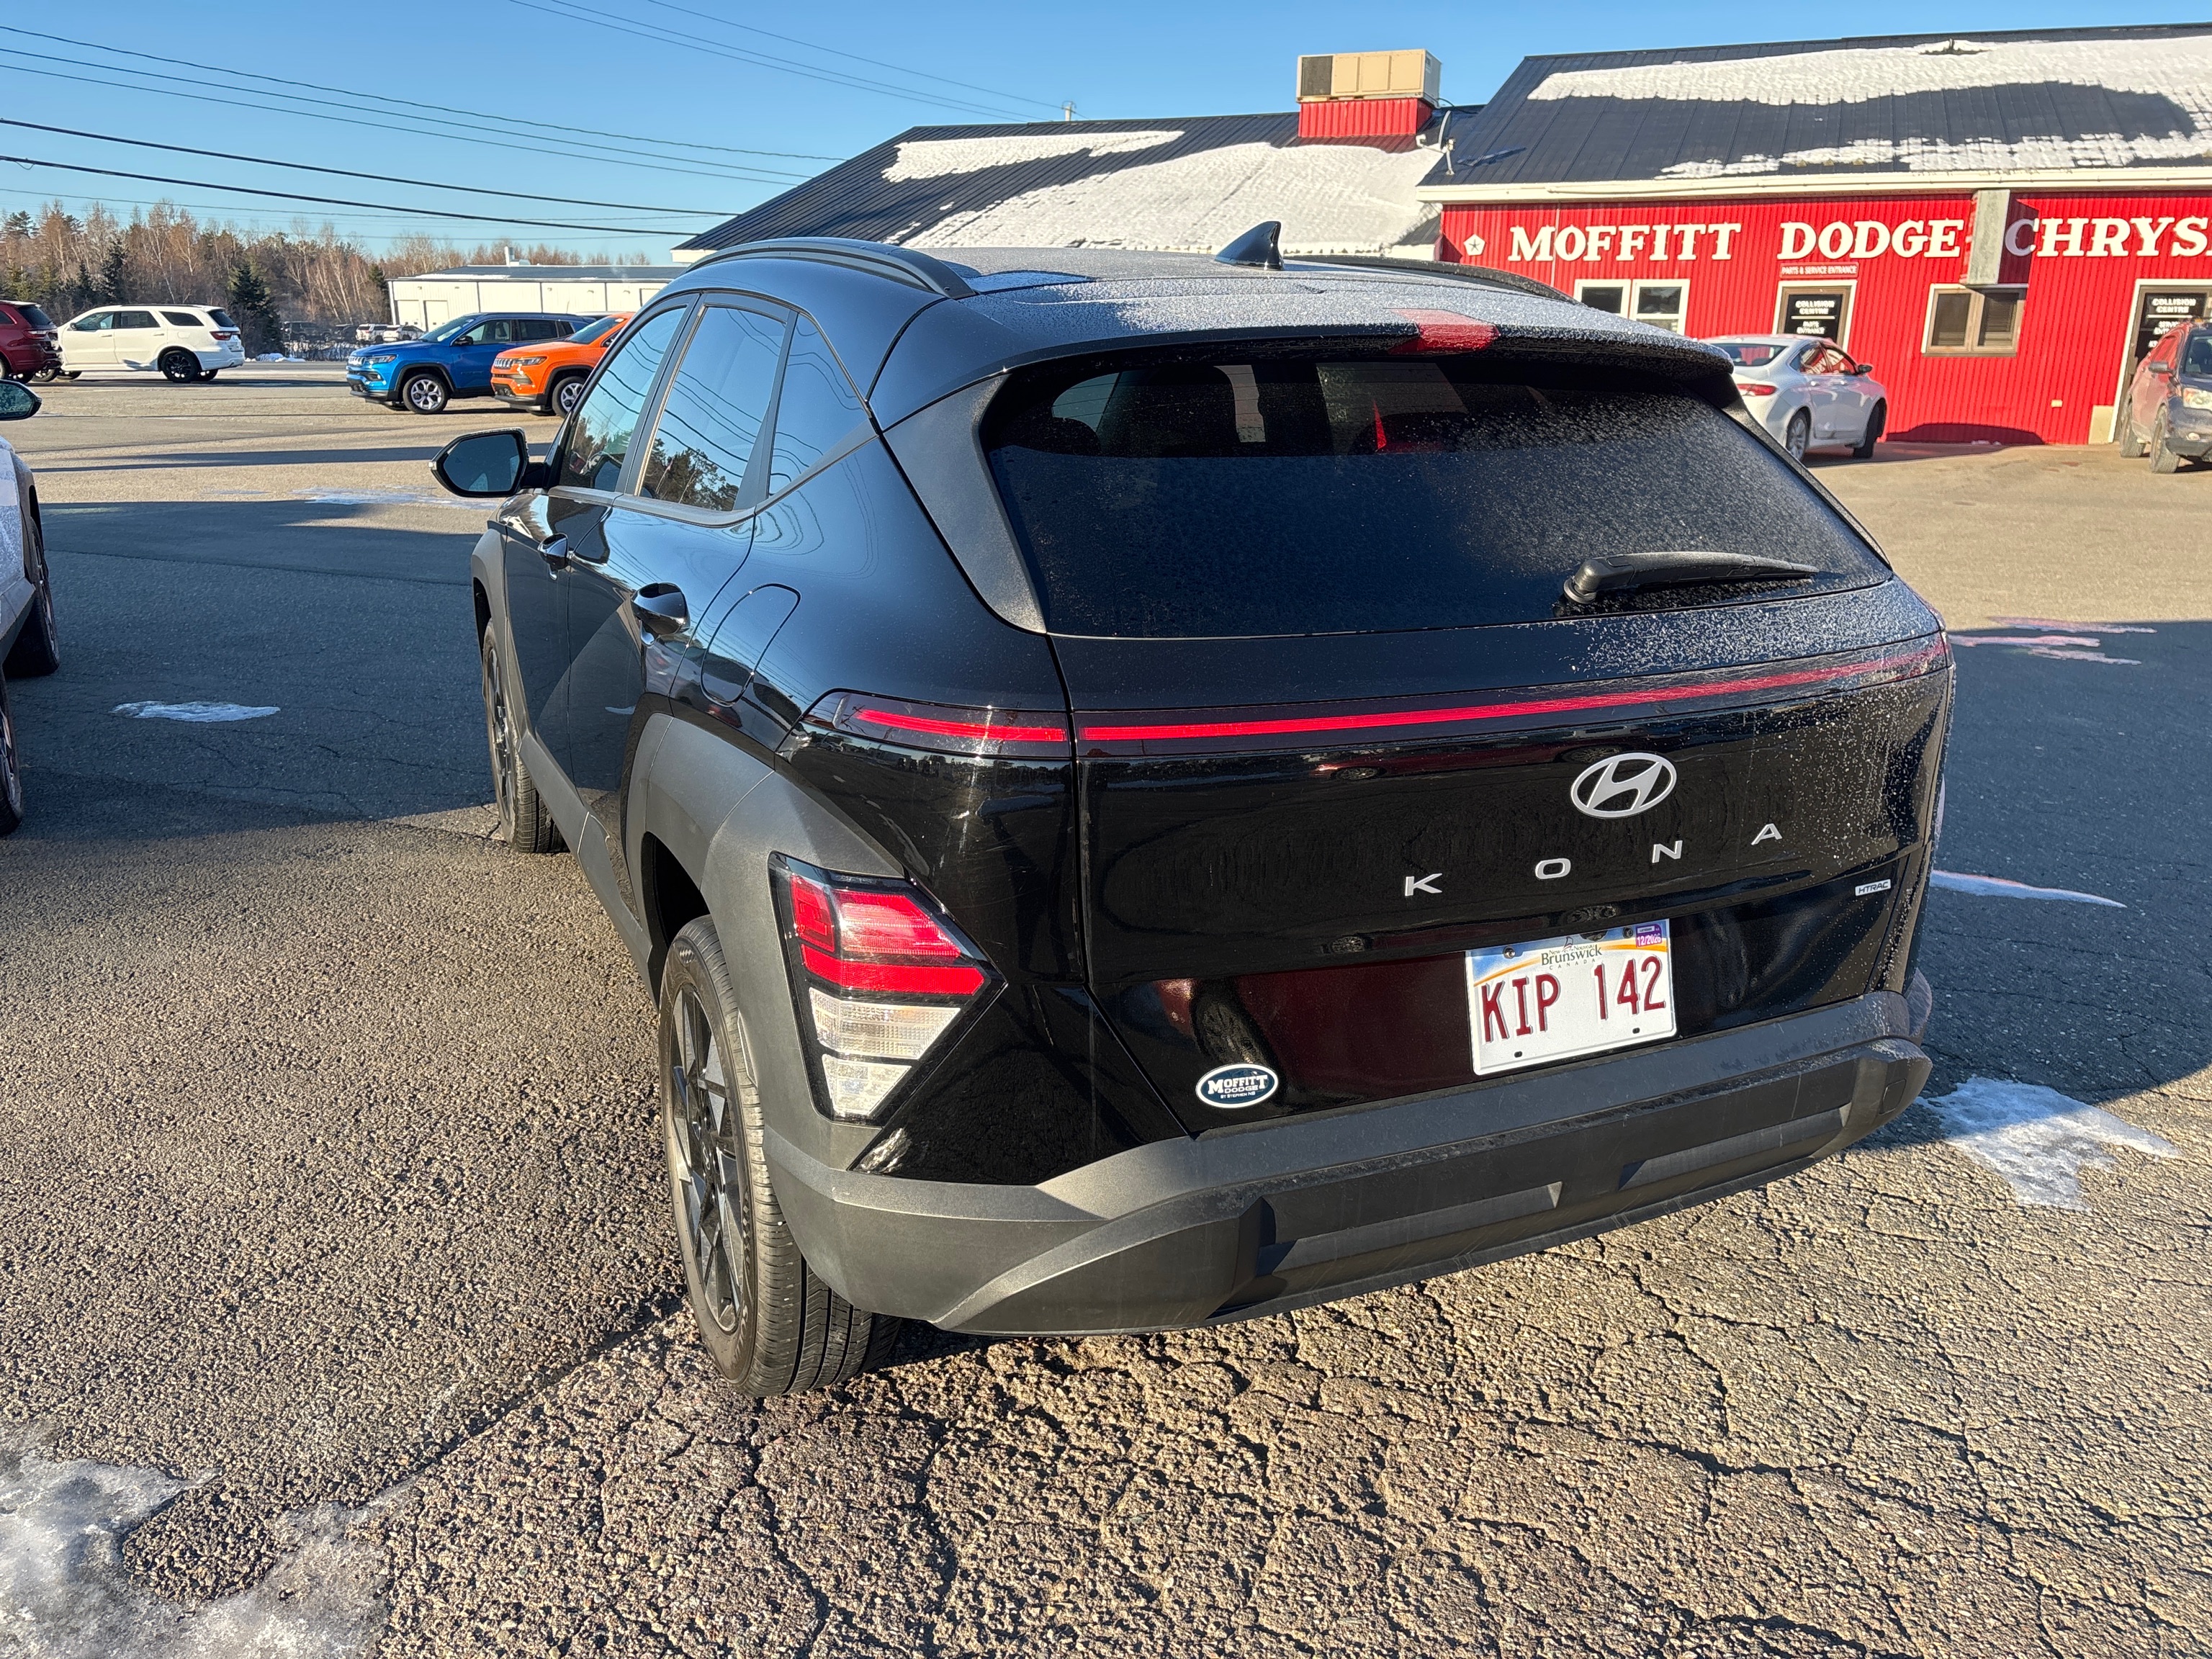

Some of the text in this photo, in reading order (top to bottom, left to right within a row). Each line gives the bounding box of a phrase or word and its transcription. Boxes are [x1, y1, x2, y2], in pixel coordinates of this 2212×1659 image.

[1507, 215, 2212, 262] MOFFITT DODGE CHRYS
[1781, 266, 1799, 275] PARTS
[1804, 266, 1827, 274] SERVICE
[1827, 265, 1857, 274] ENTRANCE
[1404, 822, 1783, 897] KONA
[1858, 881, 1889, 894] HTRAC
[1637, 932, 1661, 946] 12/2026
[1541, 944, 1602, 966] Brunswick
[1549, 958, 1596, 971] CANADA
[1480, 956, 1665, 1043] KIP 142
[1208, 1074, 1268, 1094] MOFFITT
[1224, 1084, 1259, 1094] DODGE
